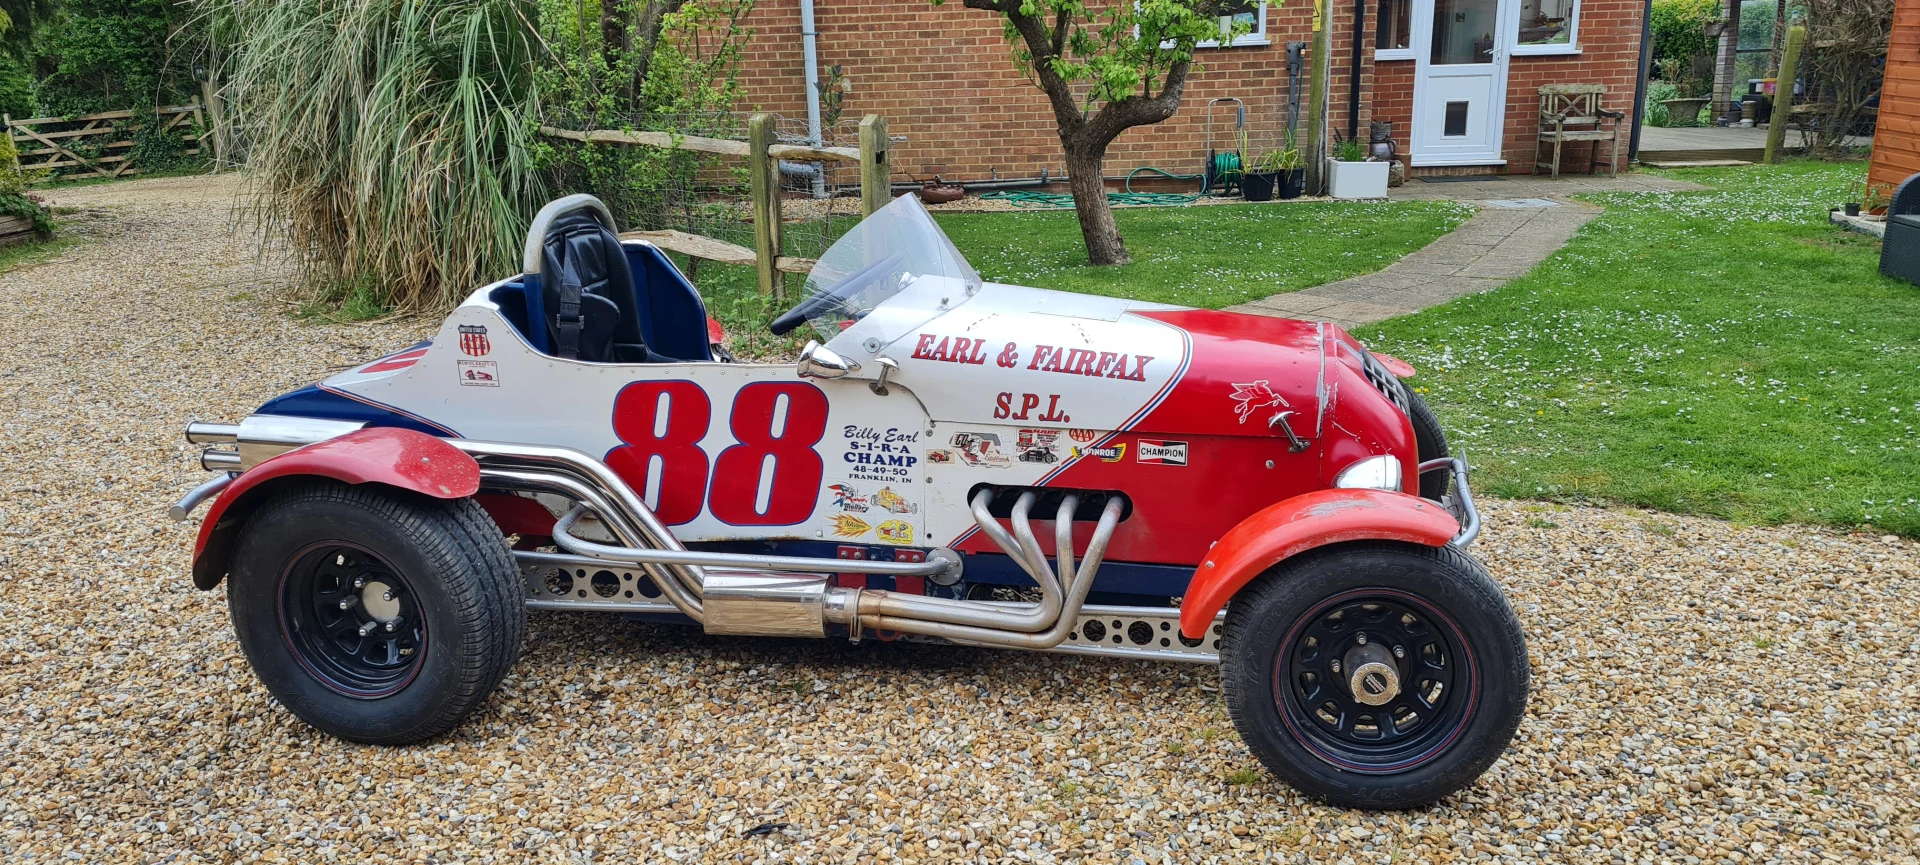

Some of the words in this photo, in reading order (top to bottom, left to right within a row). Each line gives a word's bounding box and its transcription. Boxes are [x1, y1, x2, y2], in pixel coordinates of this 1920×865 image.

[911, 334, 987, 365] EARL
[997, 342, 1018, 368] &
[1027, 345, 1154, 382] FAIRFAX
[994, 392, 1070, 423] S.P.L.
[844, 425, 880, 443] Billy
[884, 428, 919, 443] Earl
[1071, 429, 1093, 442] AAA
[603, 379, 829, 526] 88
[850, 441, 911, 454] S-I-R-A
[1081, 448, 1116, 457] MONROE
[1140, 447, 1184, 458] CHAMPION
[844, 452, 918, 467] CHAMP
[853, 465, 908, 476] 48-49-50
